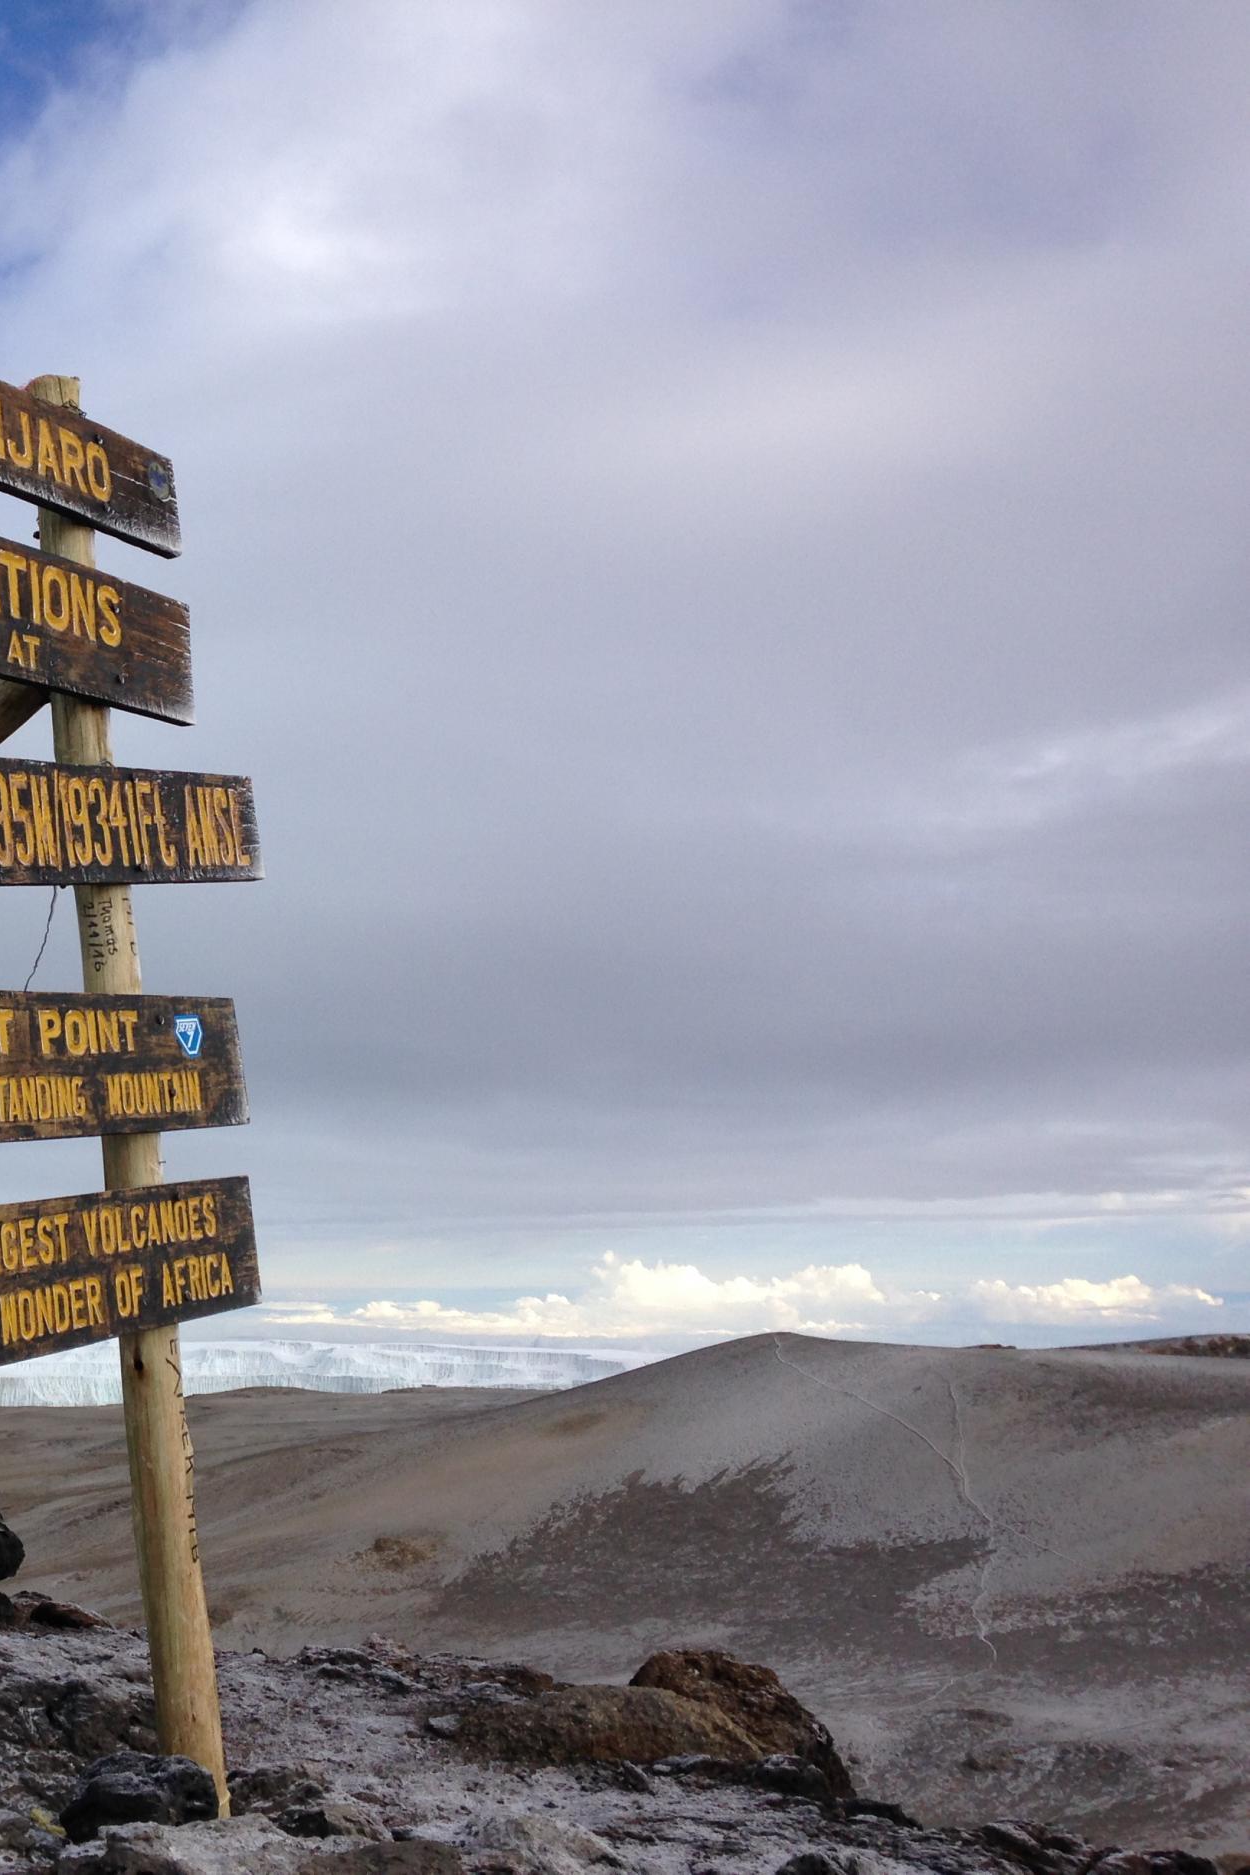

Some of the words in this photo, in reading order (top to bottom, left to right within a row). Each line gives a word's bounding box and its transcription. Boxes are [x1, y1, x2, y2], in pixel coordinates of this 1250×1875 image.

[6, 629, 41, 671] AT
[38, 1008, 139, 1057] POINT
[107, 1069, 203, 1115] MOUNTAIN
[82, 1192, 217, 1257] VOLCANOES
[0, 1276, 104, 1346] WONDER
[114, 1263, 144, 1319] OF
[161, 1252, 235, 1309] AFRICA
